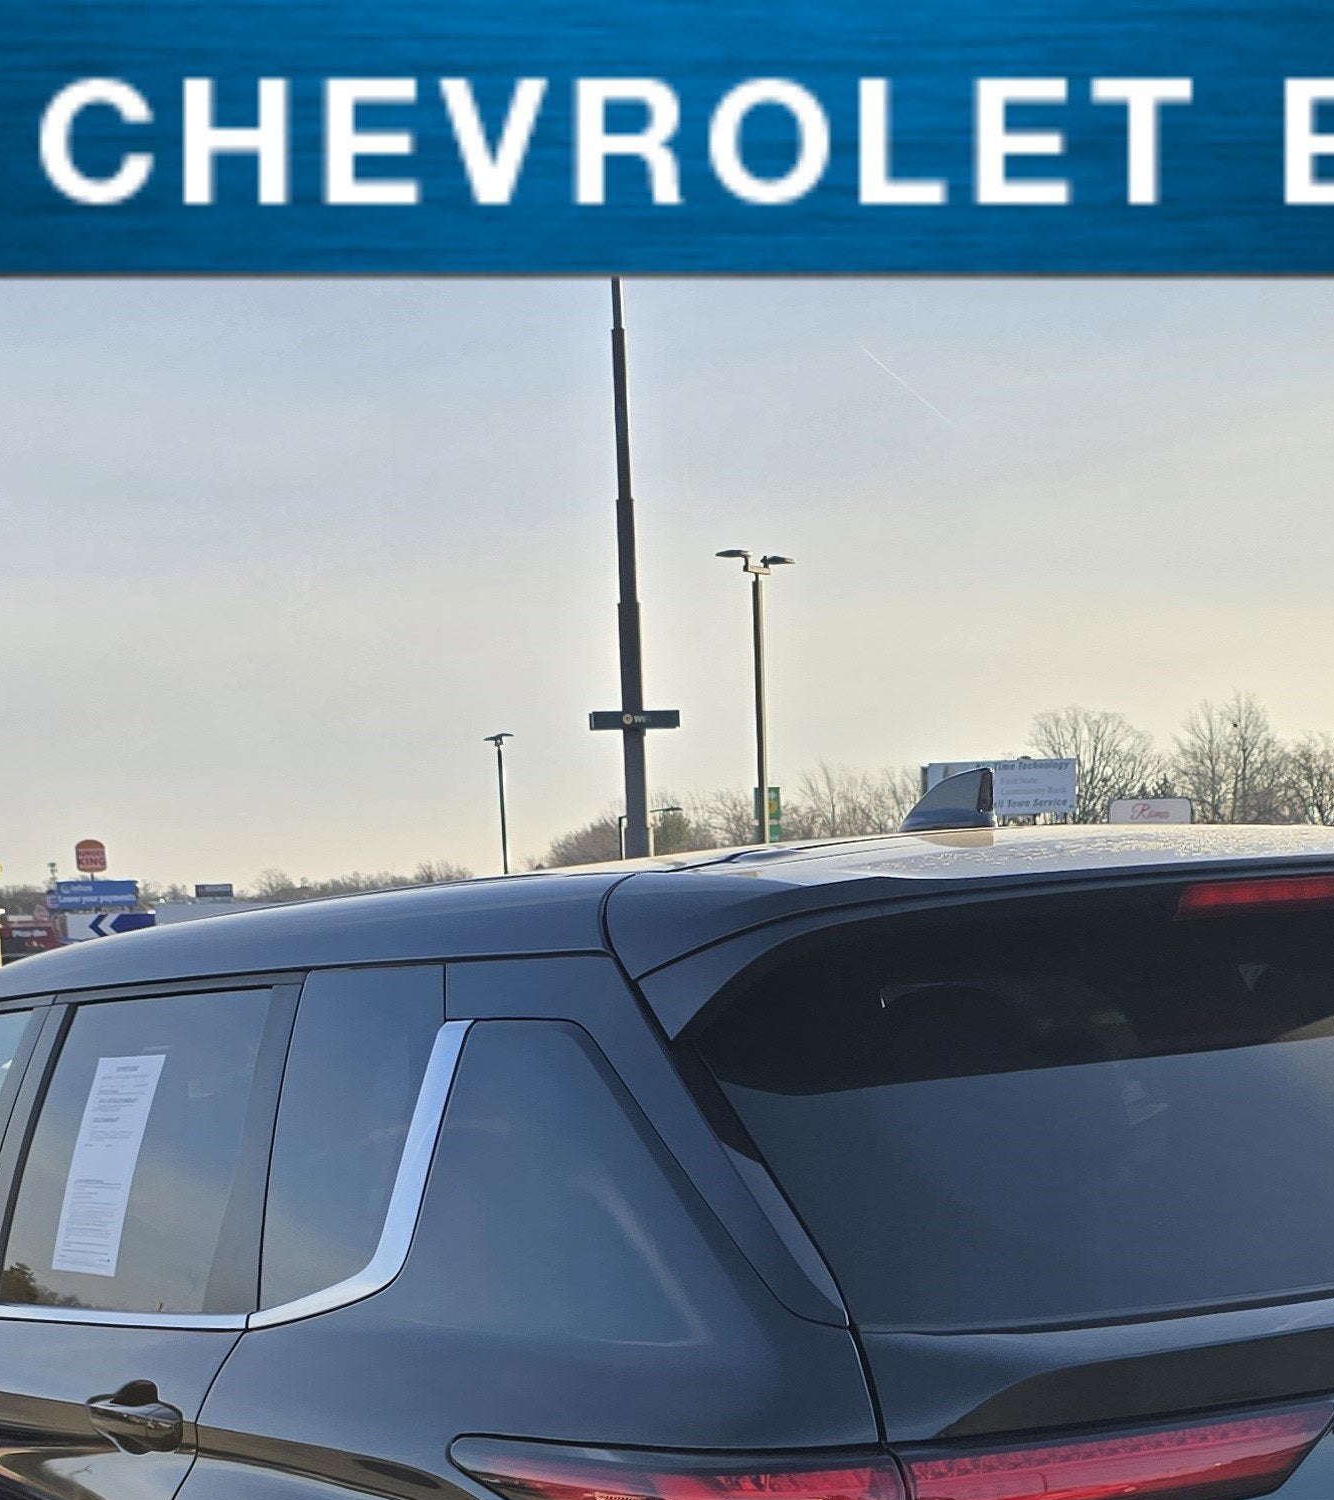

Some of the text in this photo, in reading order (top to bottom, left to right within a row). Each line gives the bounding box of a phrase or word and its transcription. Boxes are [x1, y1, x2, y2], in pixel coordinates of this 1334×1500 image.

[1018, 761, 1070, 770] Technology
[1008, 800, 1030, 809] Town
[1033, 798, 1067, 808] Service
[78, 858, 107, 867] KING
